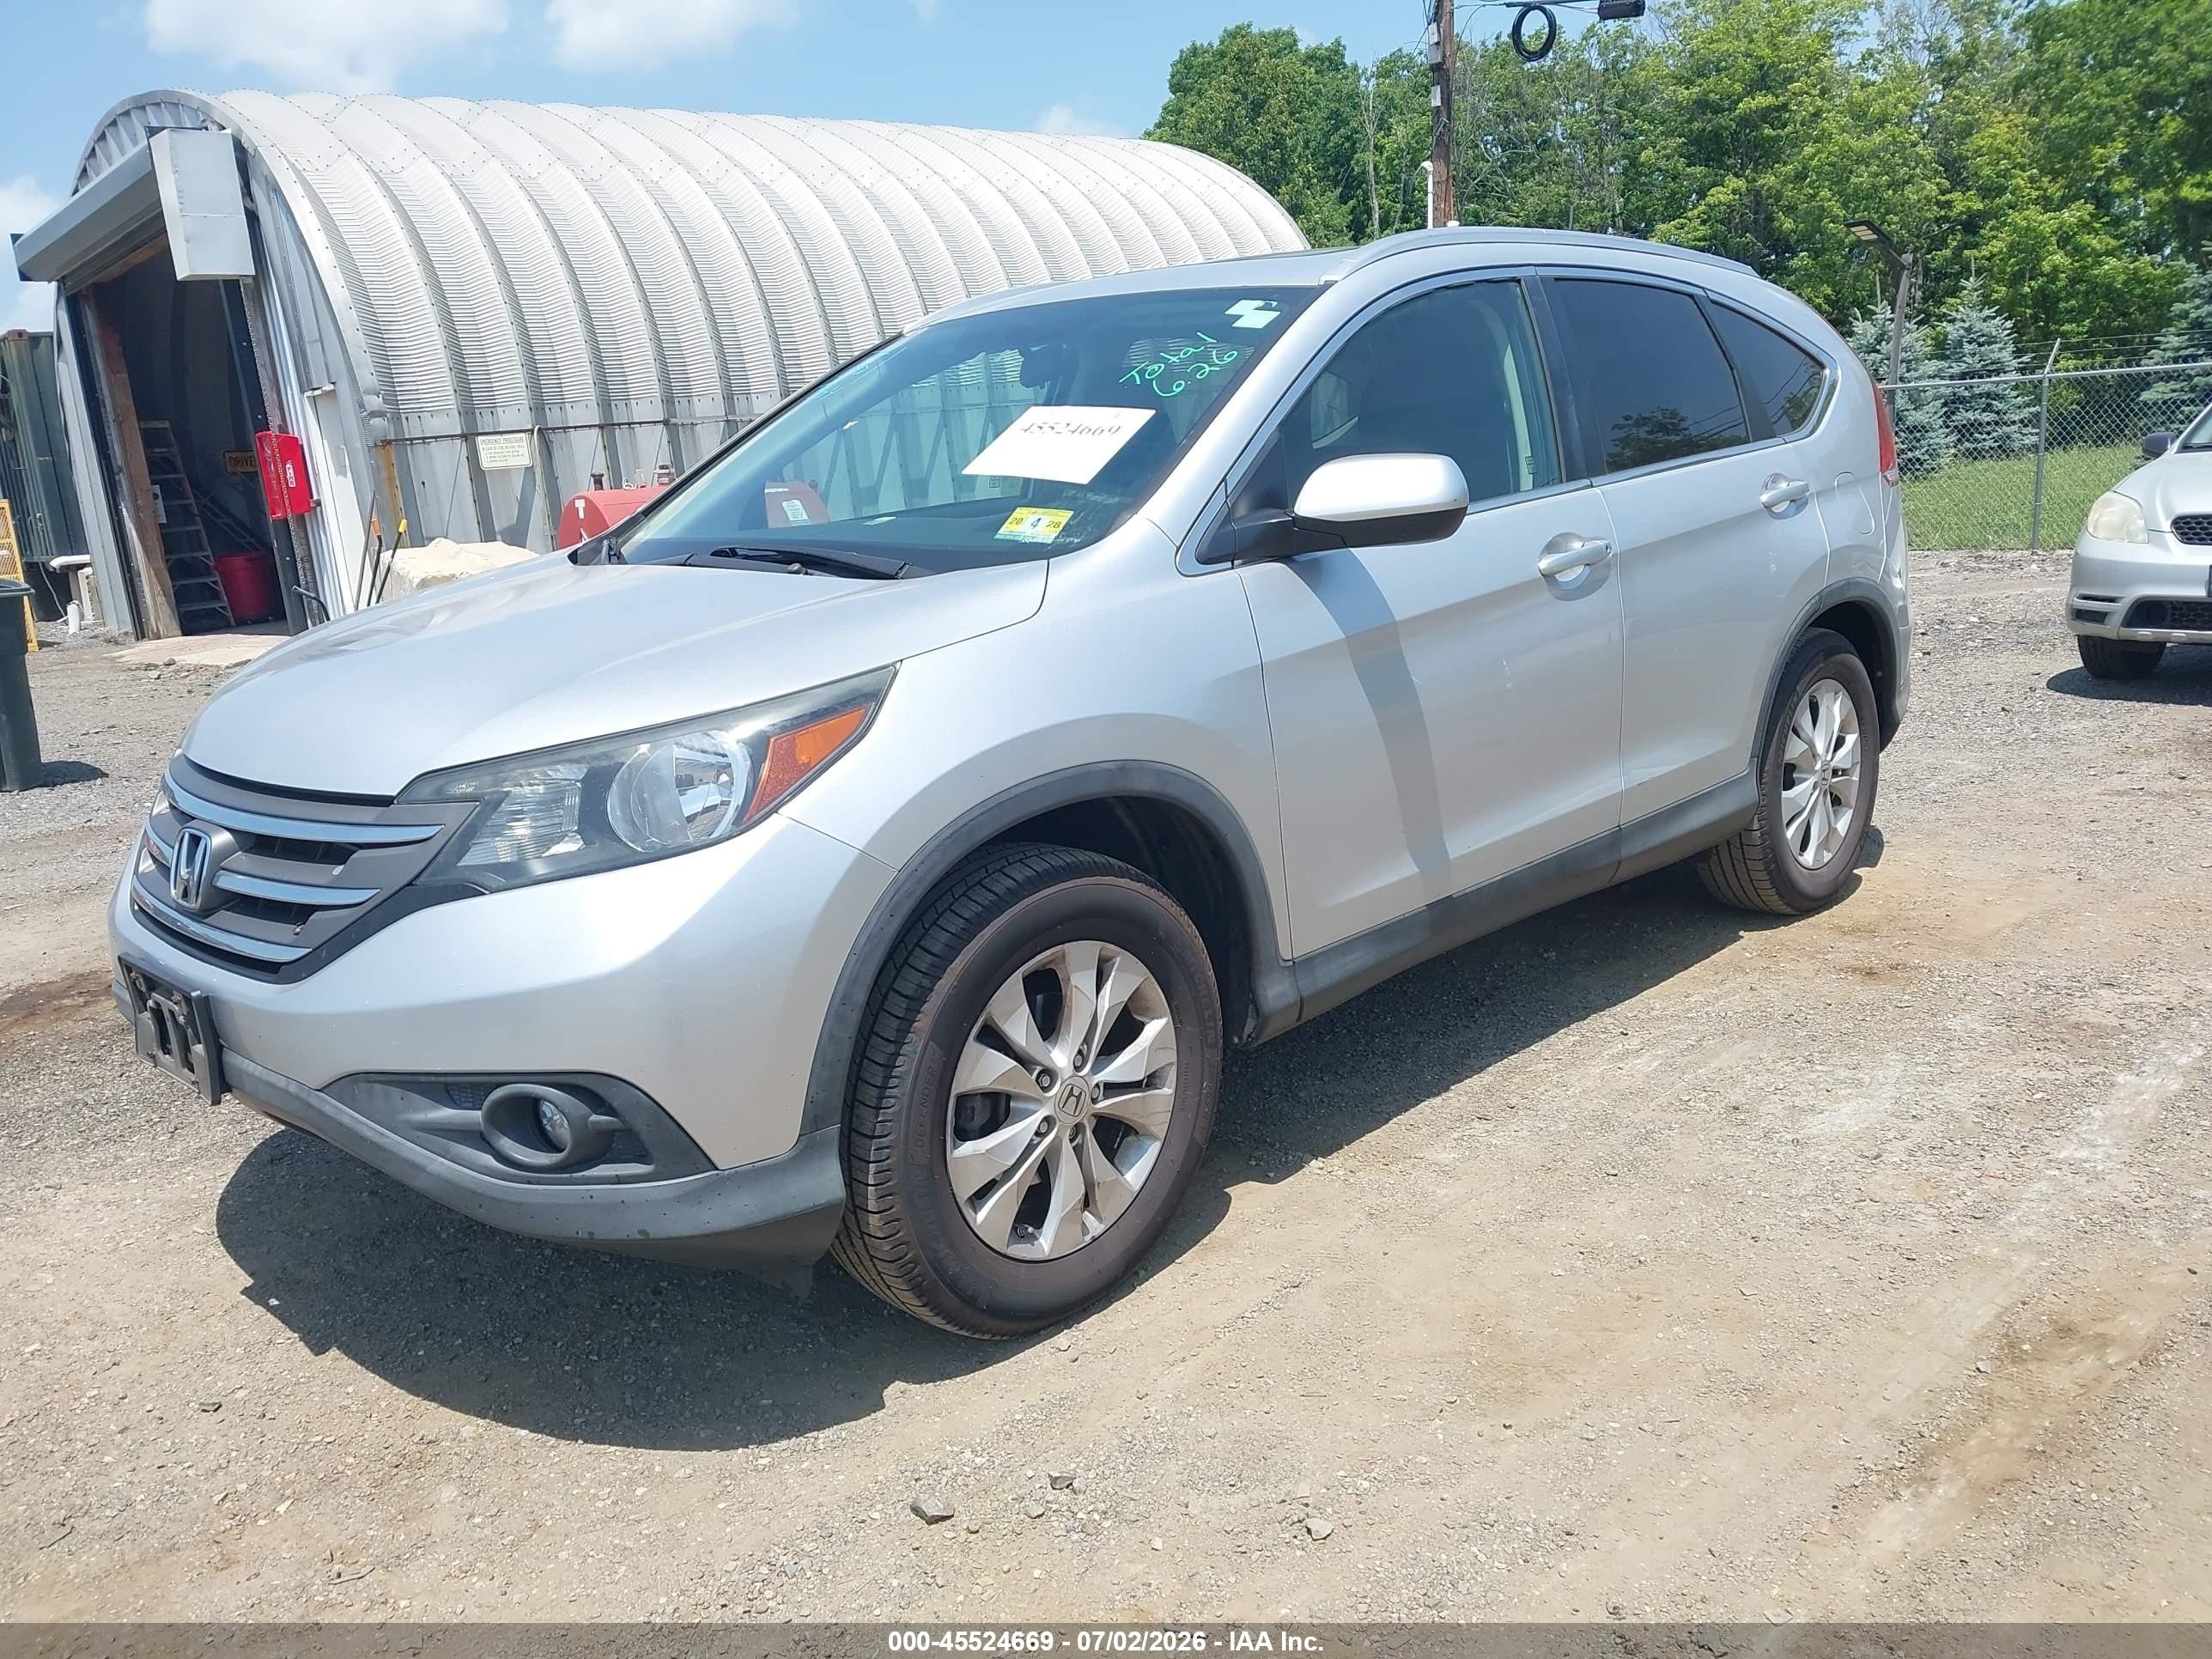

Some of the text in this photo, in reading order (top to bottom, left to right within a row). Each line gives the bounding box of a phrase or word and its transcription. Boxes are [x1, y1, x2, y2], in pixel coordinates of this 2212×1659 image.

[1152, 349, 1238, 397] 6.26
[1009, 517, 1024, 526] 20
[1030, 517, 1042, 529] 4
[915, 1065, 937, 1148] DEFENDER
